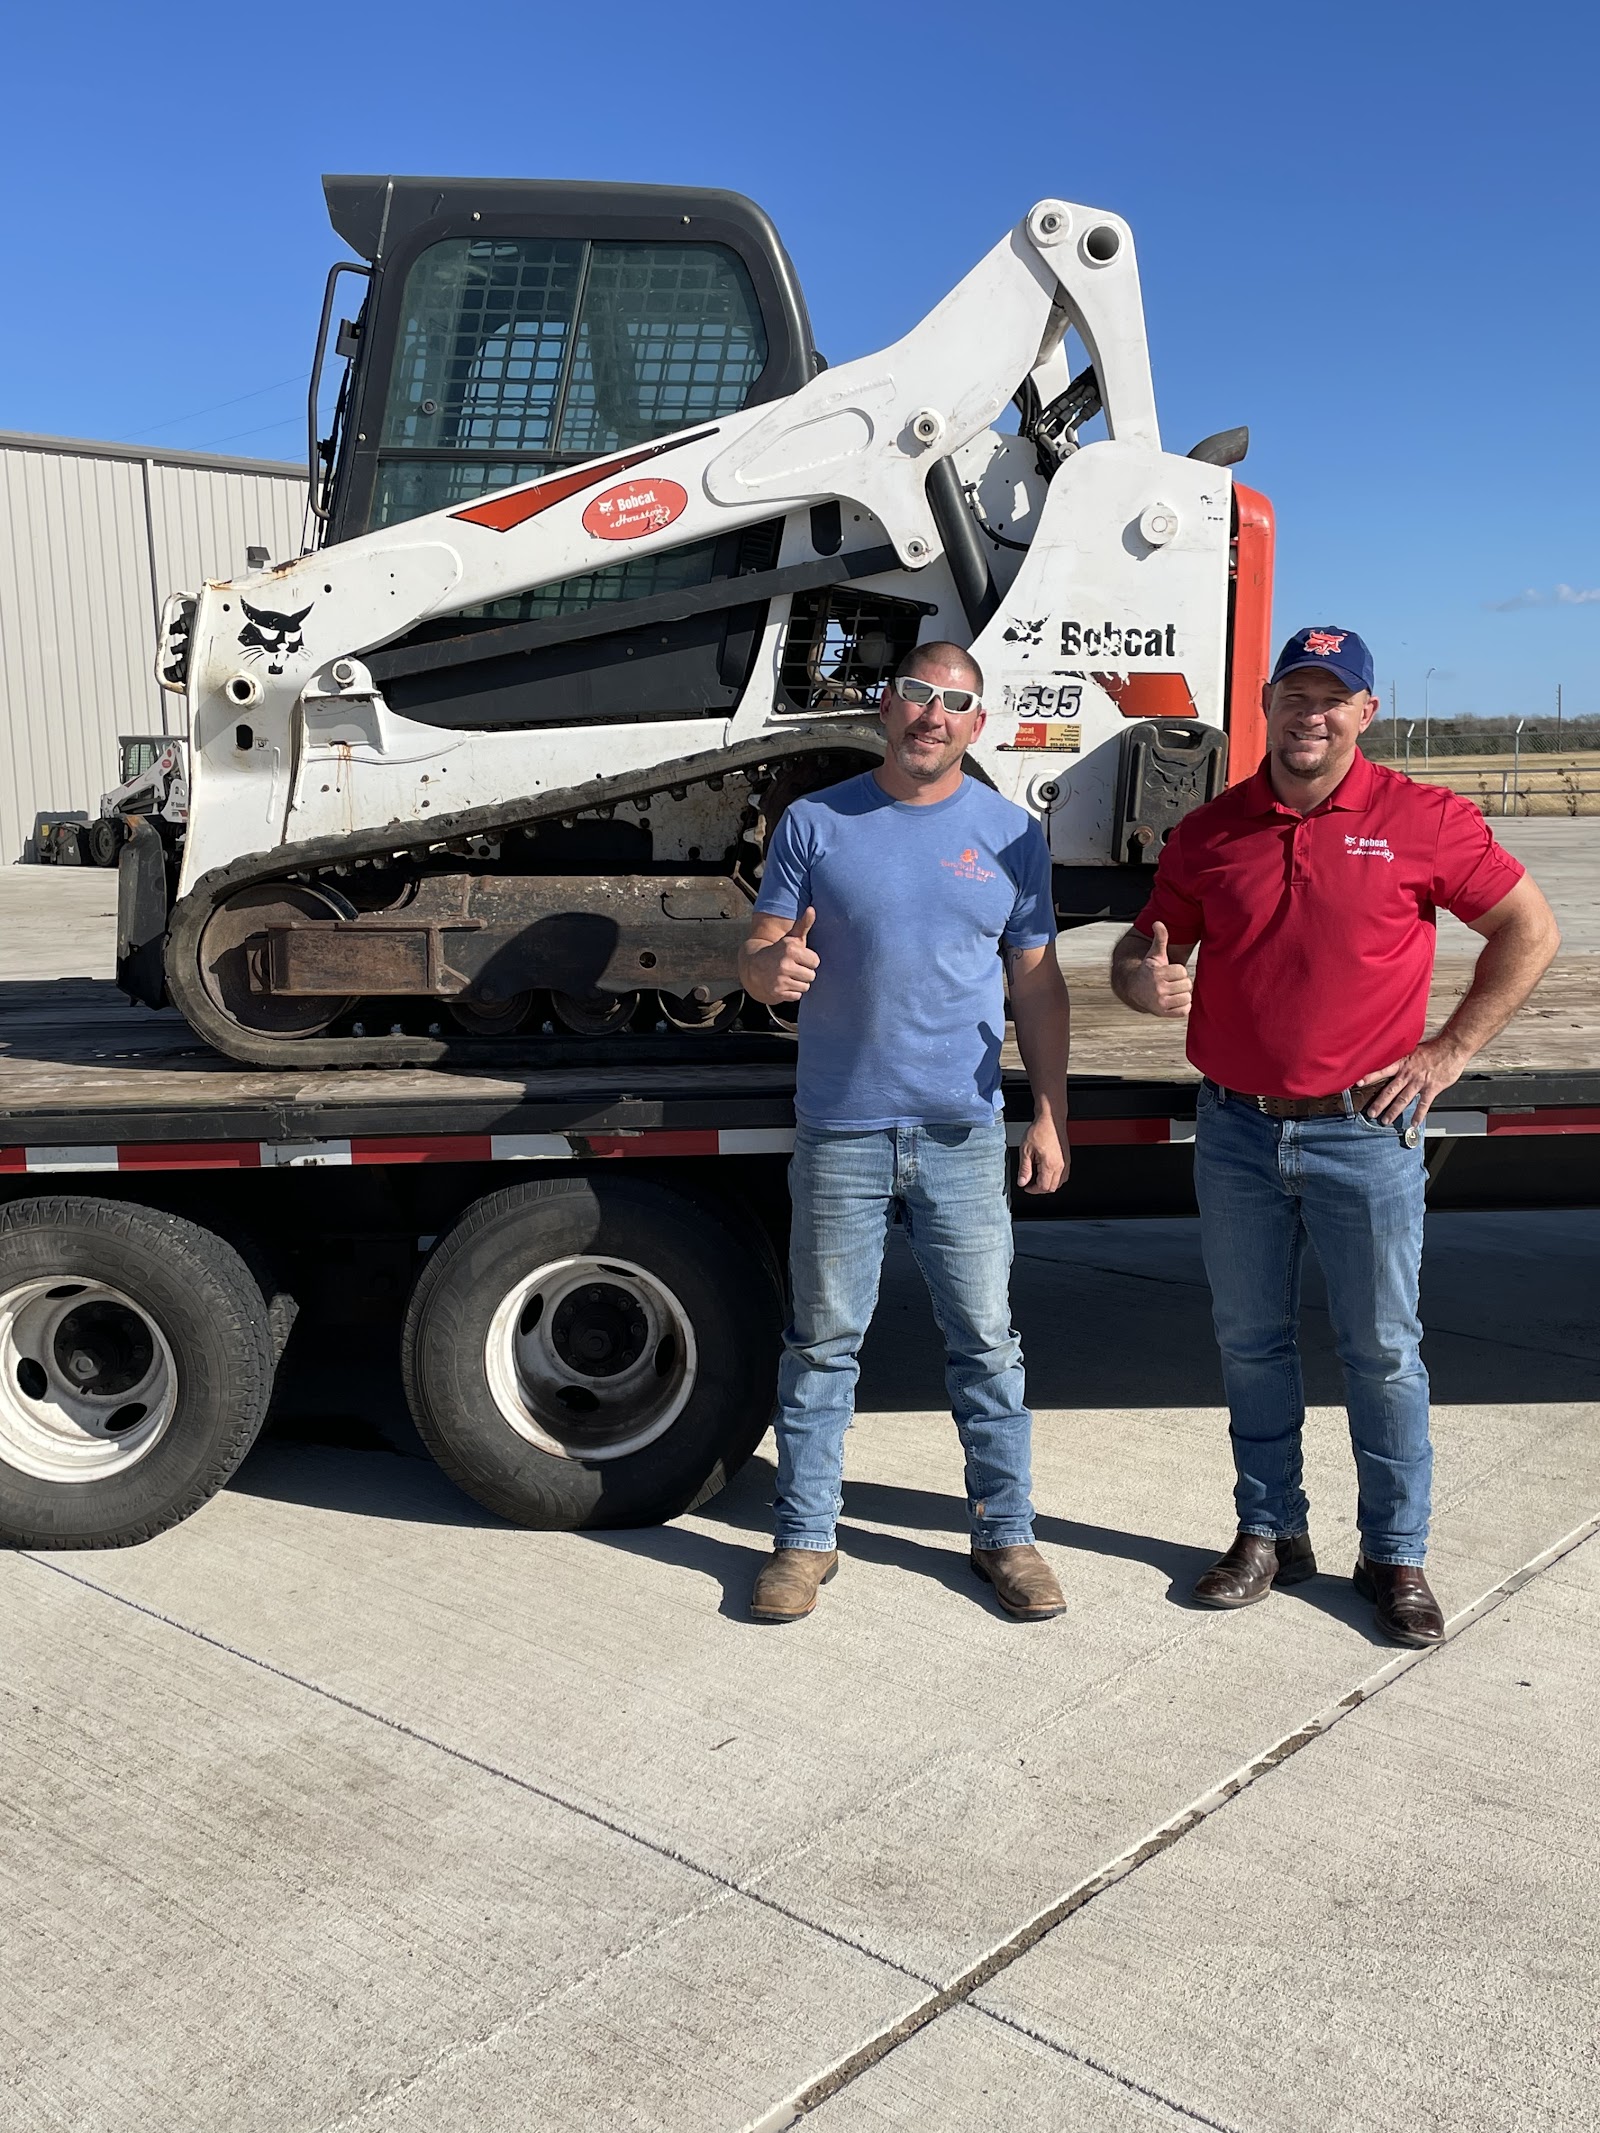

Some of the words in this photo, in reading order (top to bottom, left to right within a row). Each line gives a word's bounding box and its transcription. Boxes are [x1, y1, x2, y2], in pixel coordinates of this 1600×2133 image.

[616, 490, 657, 512] Bobcat
[1060, 621, 1177, 657] Bobcat
[1359, 838, 1388, 848] Bobcat
